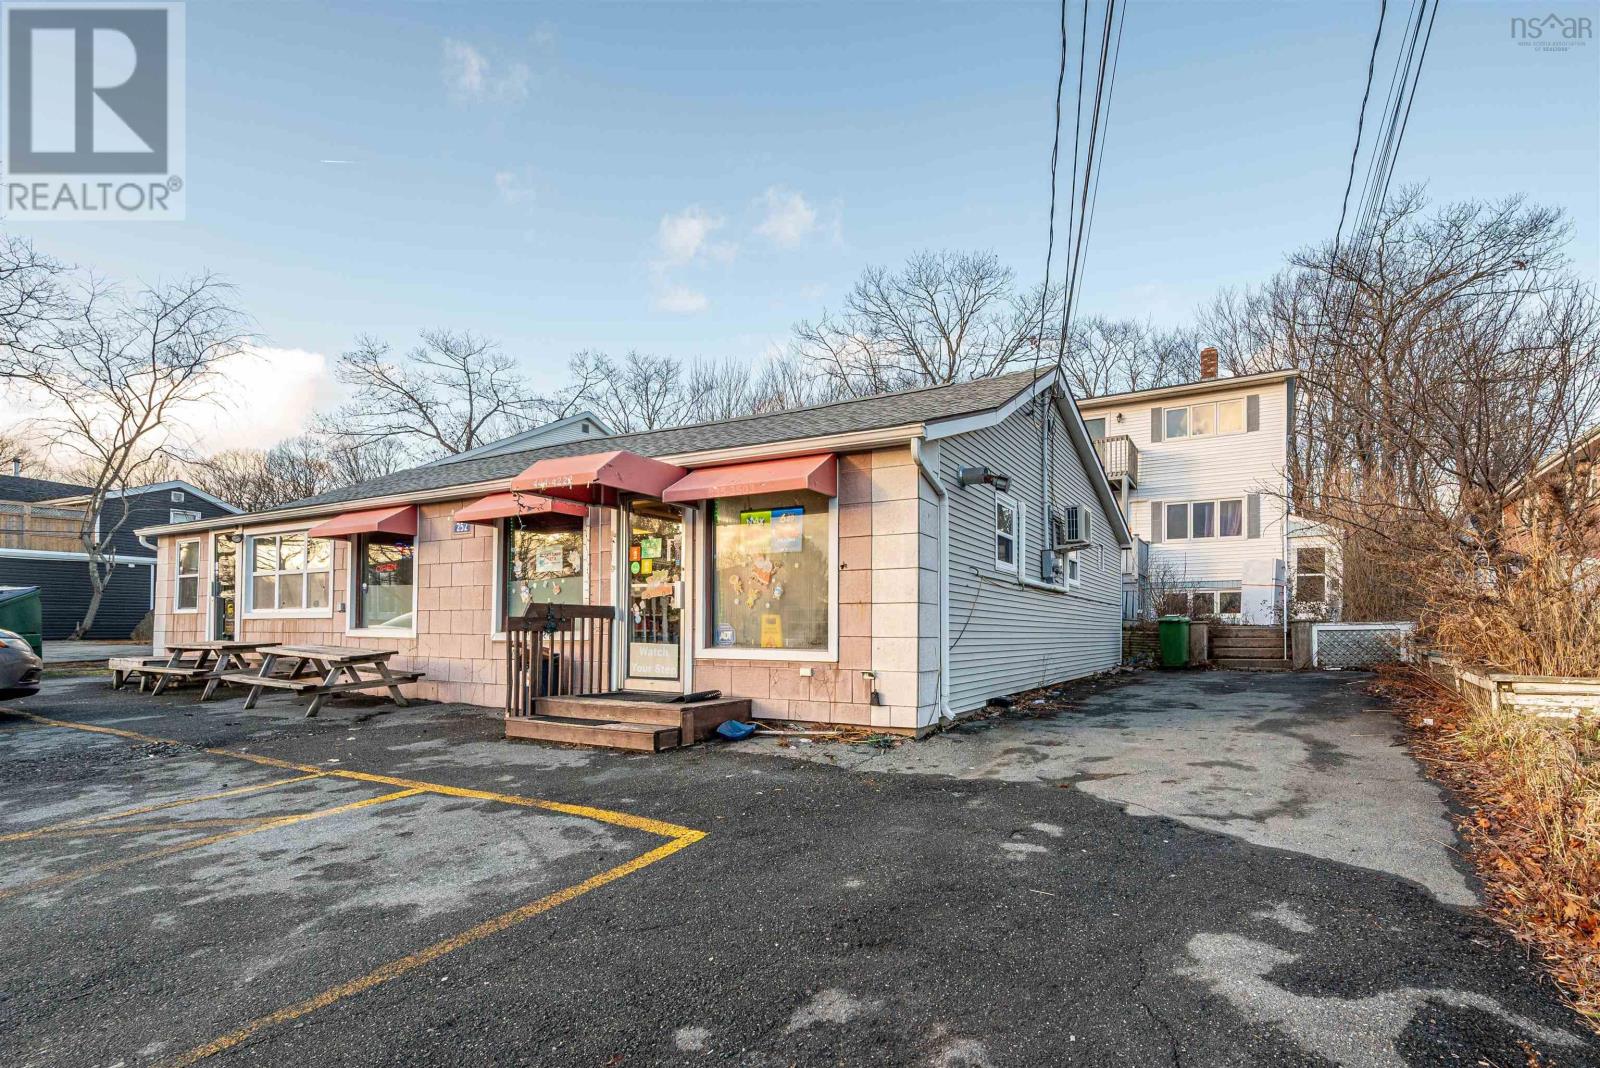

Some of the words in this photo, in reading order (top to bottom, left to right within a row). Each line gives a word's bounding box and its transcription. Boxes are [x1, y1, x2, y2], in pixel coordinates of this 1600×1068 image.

[719, 630, 734, 641] ADT
[639, 646, 669, 657] Watch
[631, 663, 651, 673] Your
[655, 663, 677, 676] Step
